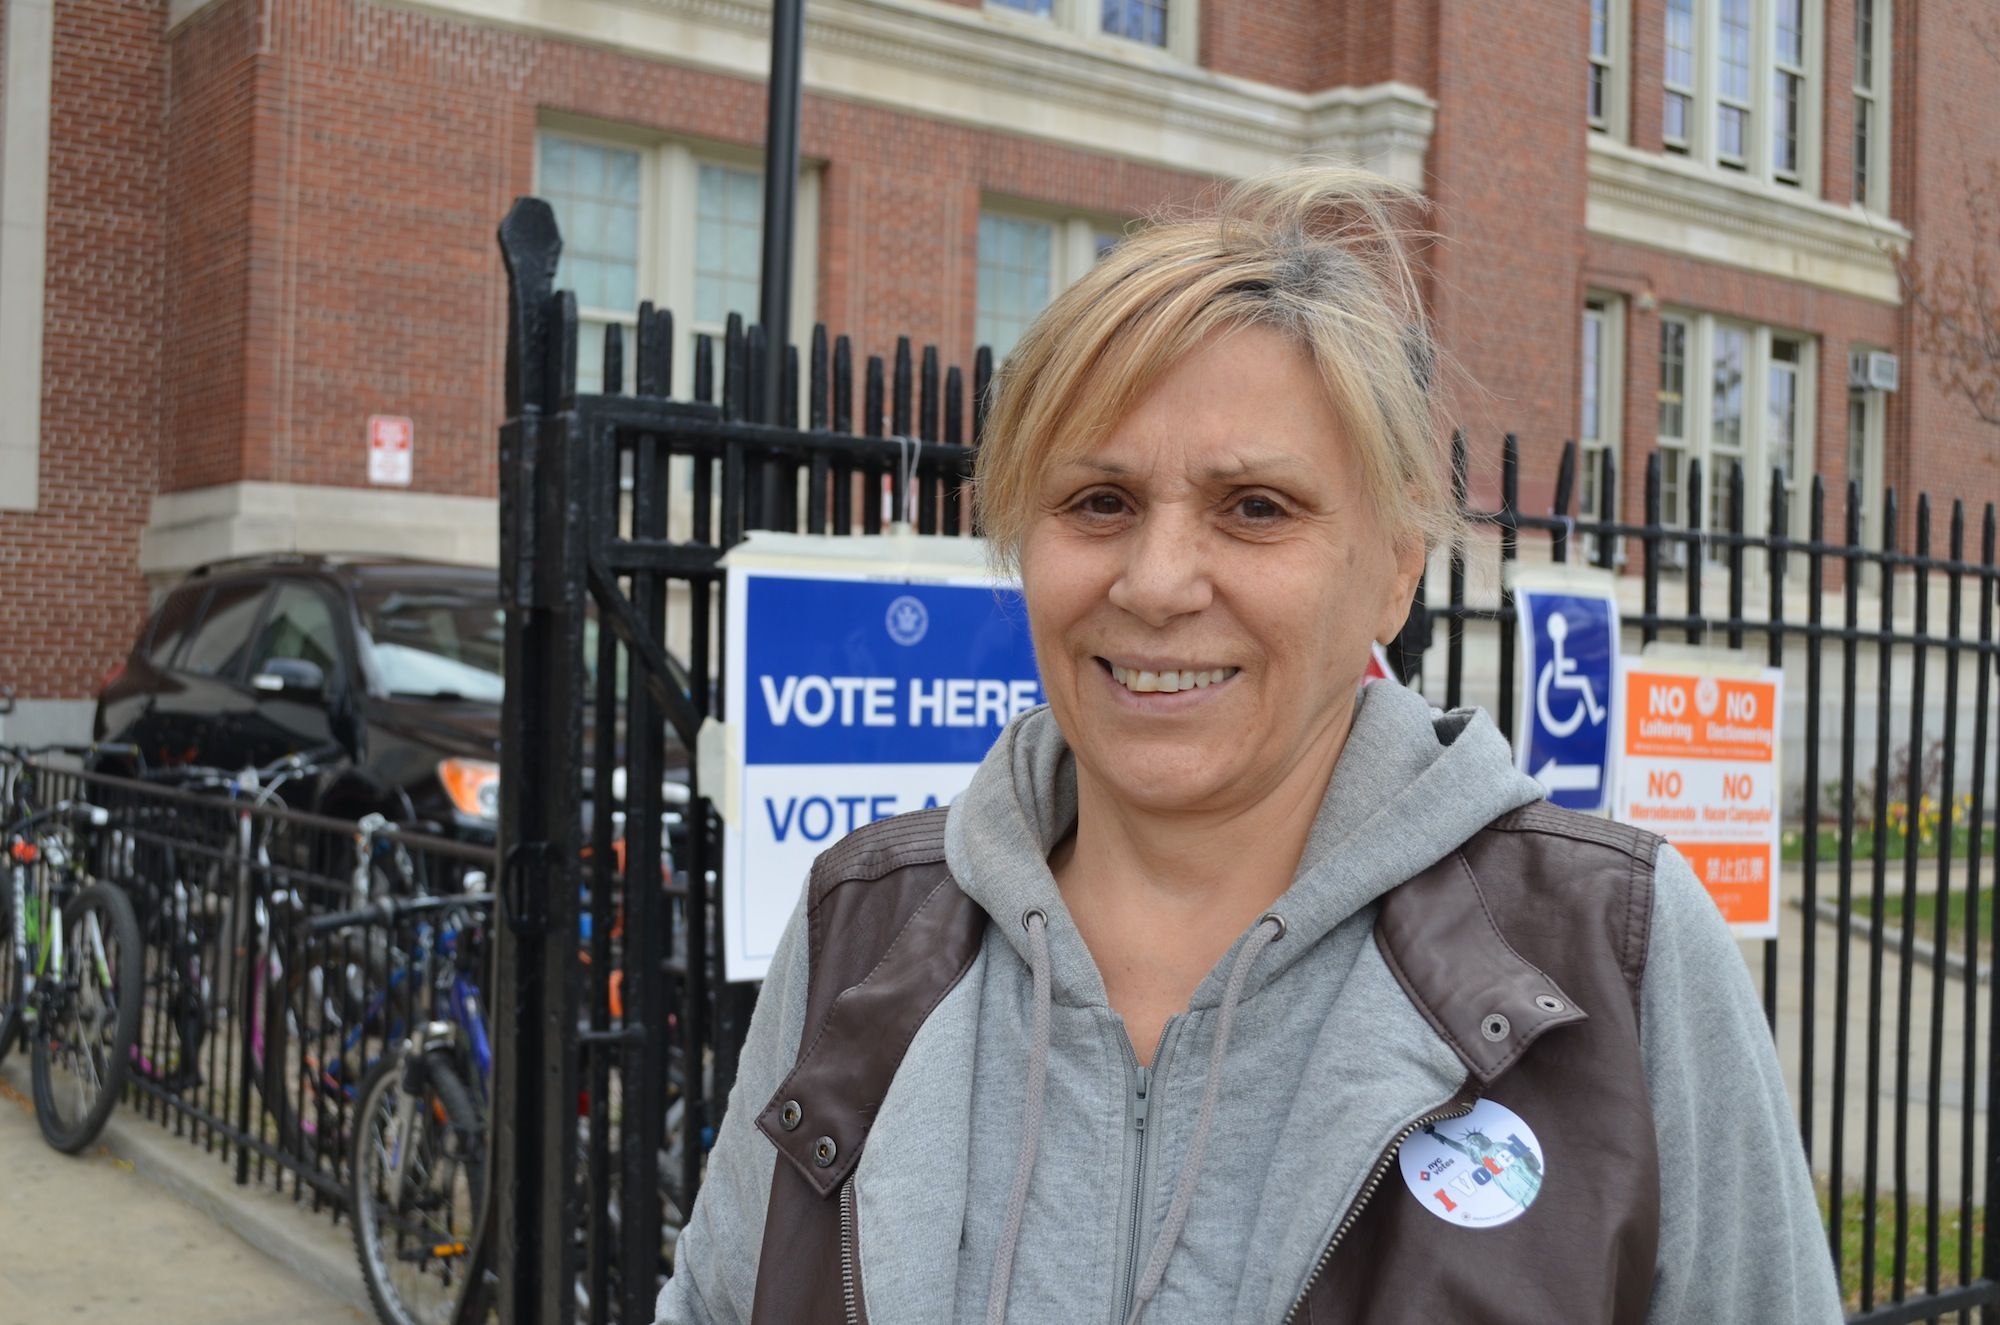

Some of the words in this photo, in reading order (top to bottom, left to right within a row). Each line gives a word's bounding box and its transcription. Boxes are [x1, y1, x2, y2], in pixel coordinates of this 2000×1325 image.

[760, 675, 896, 727] VOTE
[910, 678, 1038, 727] HERE
[1650, 686, 1685, 716] NO
[1727, 691, 1756, 721] NO
[1640, 719, 1692, 742] Loitering
[1648, 770, 1682, 799] NO
[1722, 774, 1753, 802] NO
[1428, 1157, 1442, 1170] nyc
[1433, 1159, 1455, 1175] votes
[1434, 1188, 1457, 1212] I
[1449, 1133, 1532, 1197] Voted
